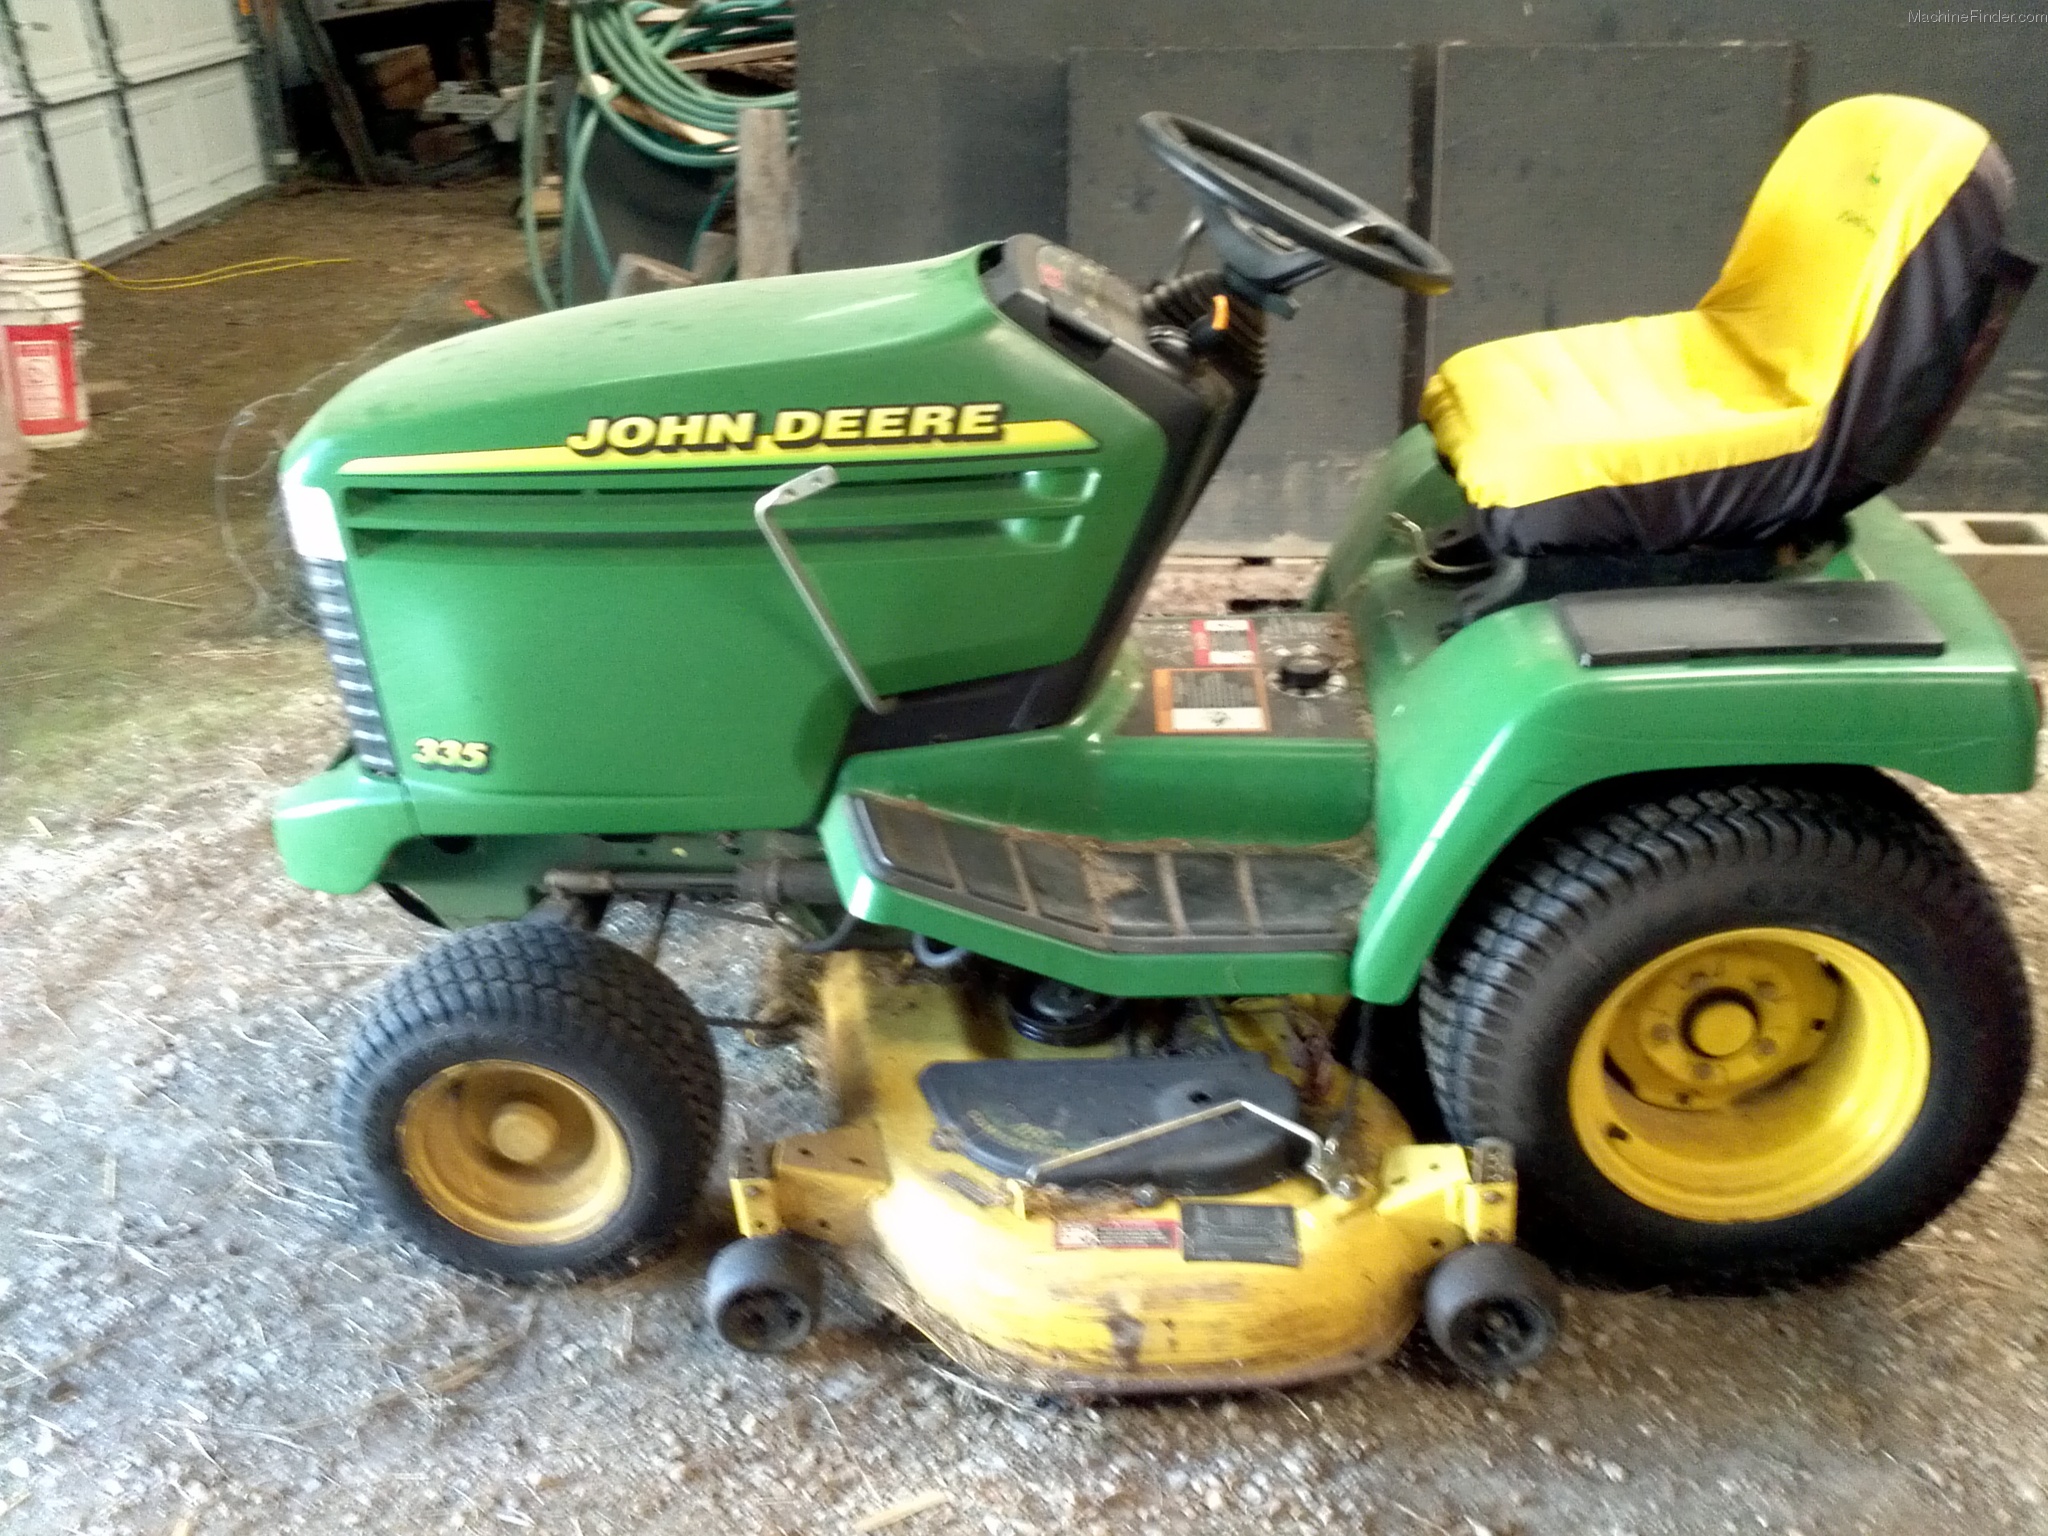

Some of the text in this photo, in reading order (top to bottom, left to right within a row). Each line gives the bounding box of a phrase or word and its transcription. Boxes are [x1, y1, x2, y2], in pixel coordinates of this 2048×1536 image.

[567, 402, 1003, 455] JOHN DEERE
[412, 737, 490, 774] 335
